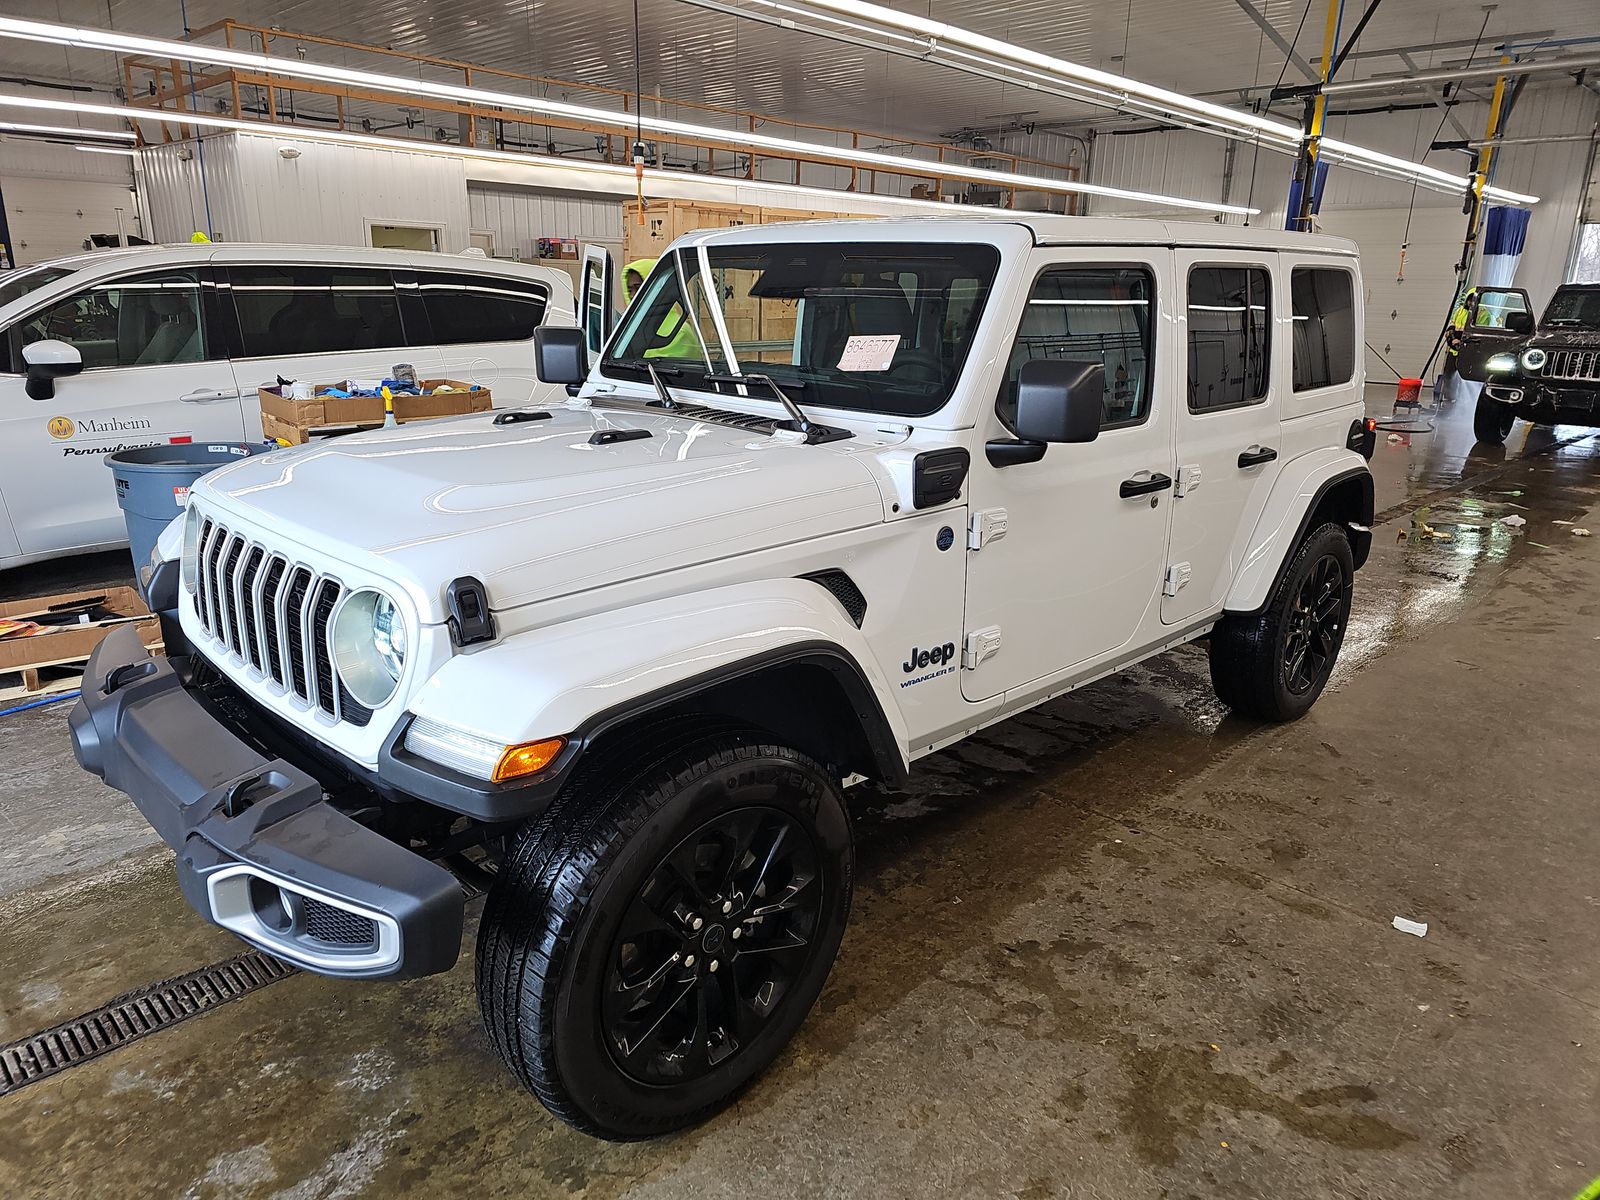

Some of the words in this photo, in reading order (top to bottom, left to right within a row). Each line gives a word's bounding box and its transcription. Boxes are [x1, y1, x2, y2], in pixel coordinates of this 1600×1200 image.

[77, 416, 151, 434] Manheim
[903, 642, 955, 673] Jeep
[900, 669, 947, 688] WRANGLER
